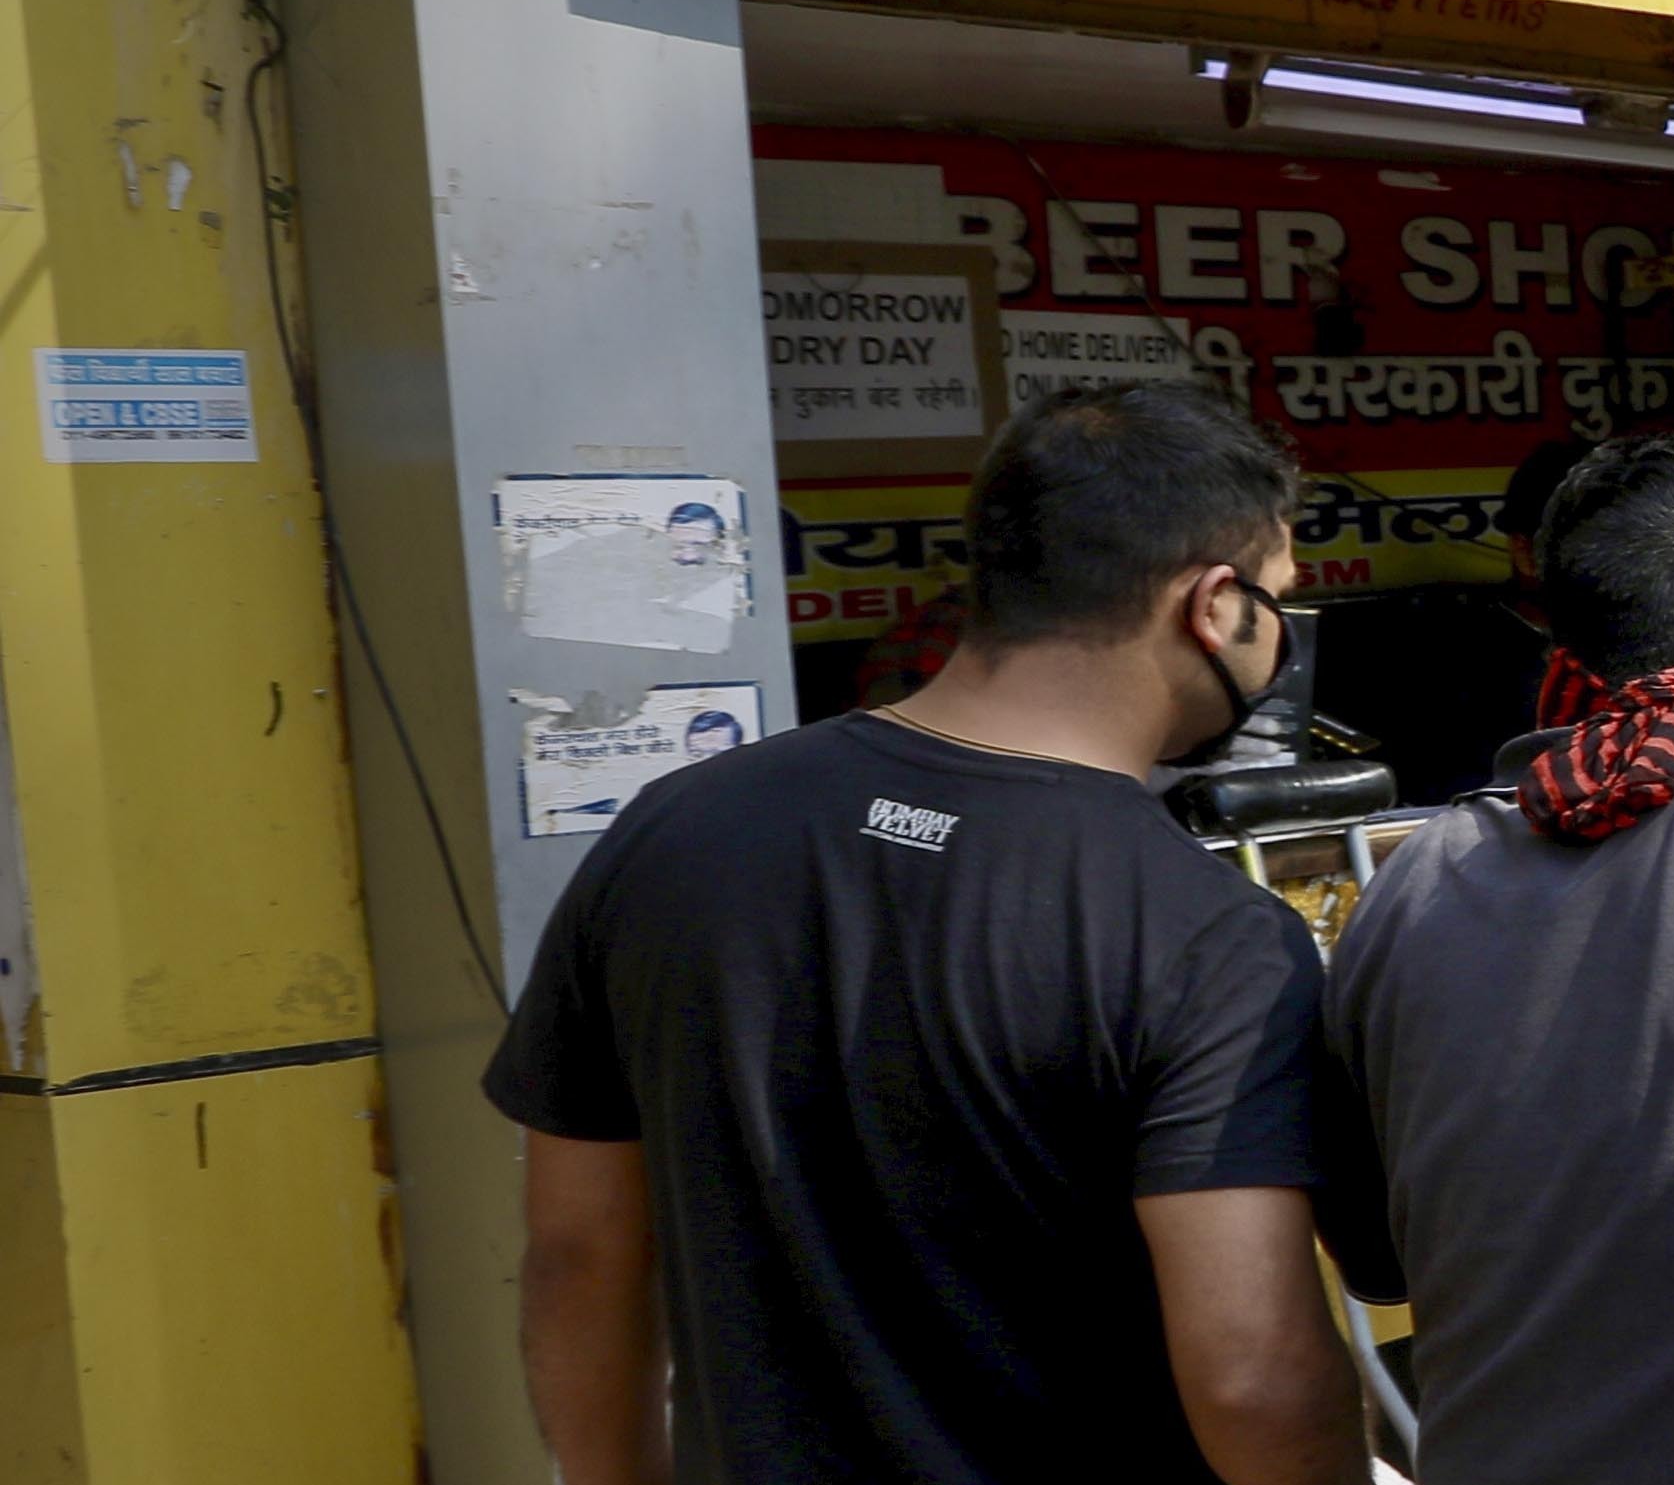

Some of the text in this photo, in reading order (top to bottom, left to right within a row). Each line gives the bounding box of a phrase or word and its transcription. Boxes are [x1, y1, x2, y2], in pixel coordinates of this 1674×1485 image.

[943, 194, 1346, 304] BEER
[771, 337, 934, 365] DRY DAY
[1018, 332, 1079, 360] HOME
[1087, 332, 1180, 365] DELIVERY
[1272, 330, 1543, 422] सरकारी
[793, 386, 857, 419] दुकान
[868, 378, 901, 409] बंद
[866, 813, 954, 844] VELVET
